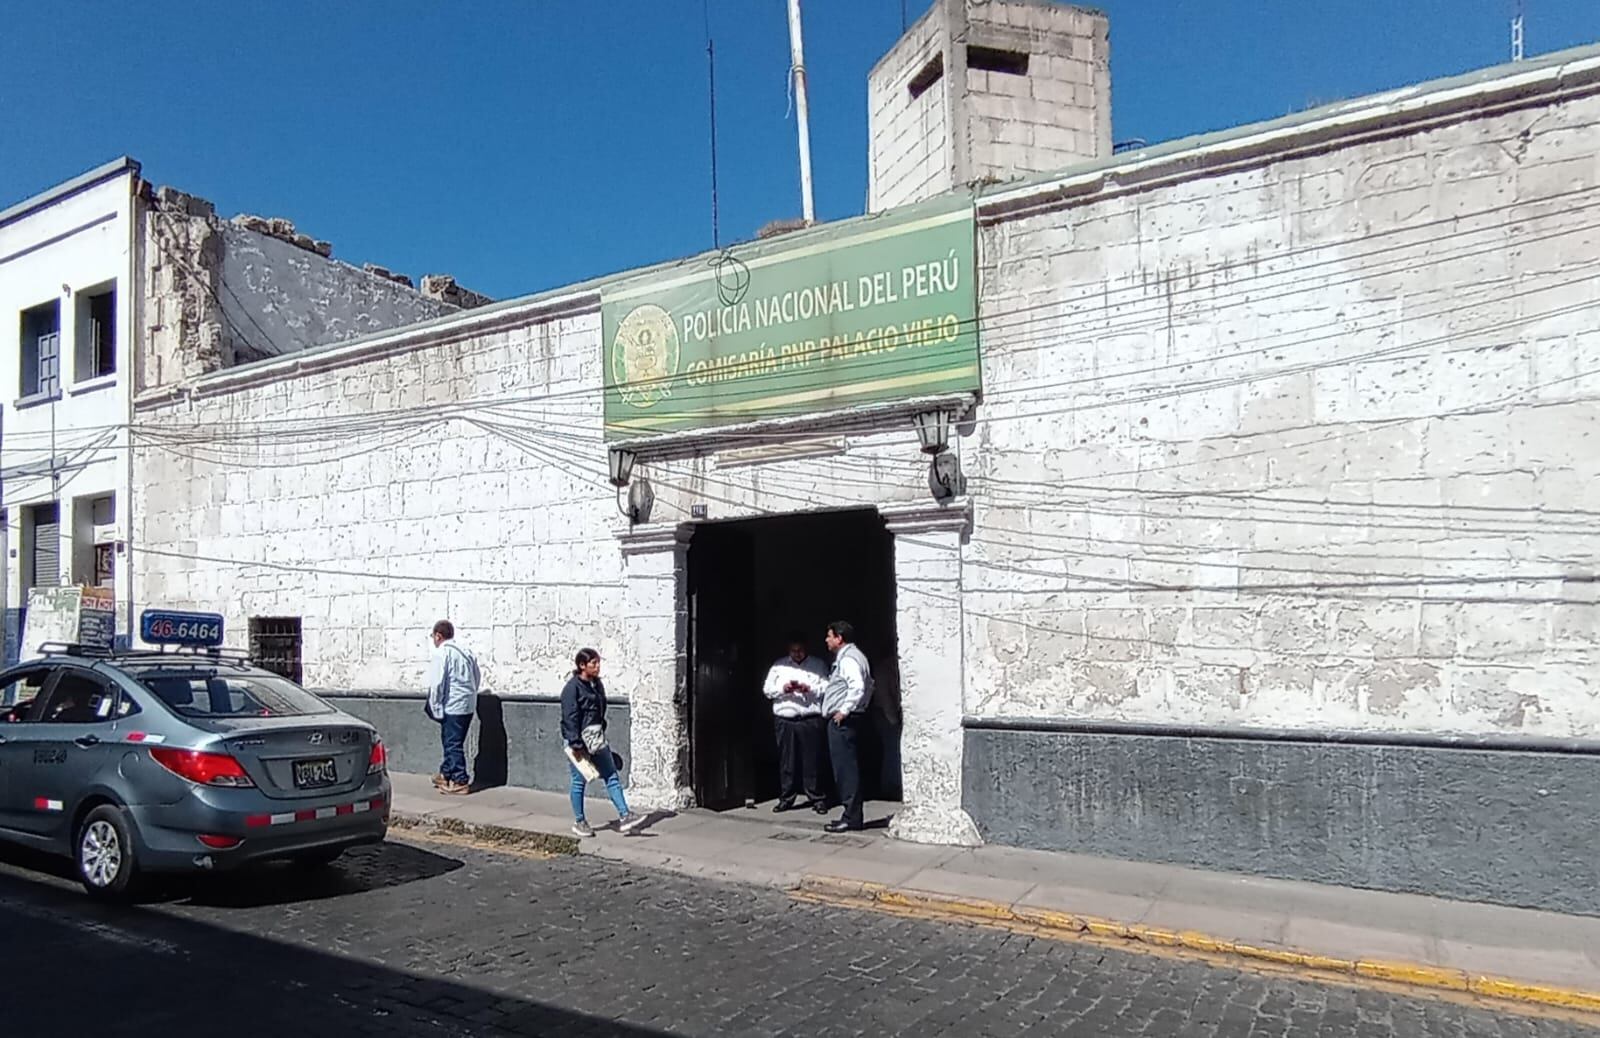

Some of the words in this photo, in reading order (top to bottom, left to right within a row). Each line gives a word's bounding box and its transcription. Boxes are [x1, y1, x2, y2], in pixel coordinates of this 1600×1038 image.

[755, 281, 855, 329] NACIONAL
[858, 271, 898, 308] DEL
[901, 248, 959, 299] PERÚ
[686, 342, 777, 387] COMISARÍA
[781, 341, 816, 371] PNP
[820, 325, 899, 363] PALACIO
[902, 314, 960, 348] VIEJO
[150, 619, 219, 640] 46-6464
